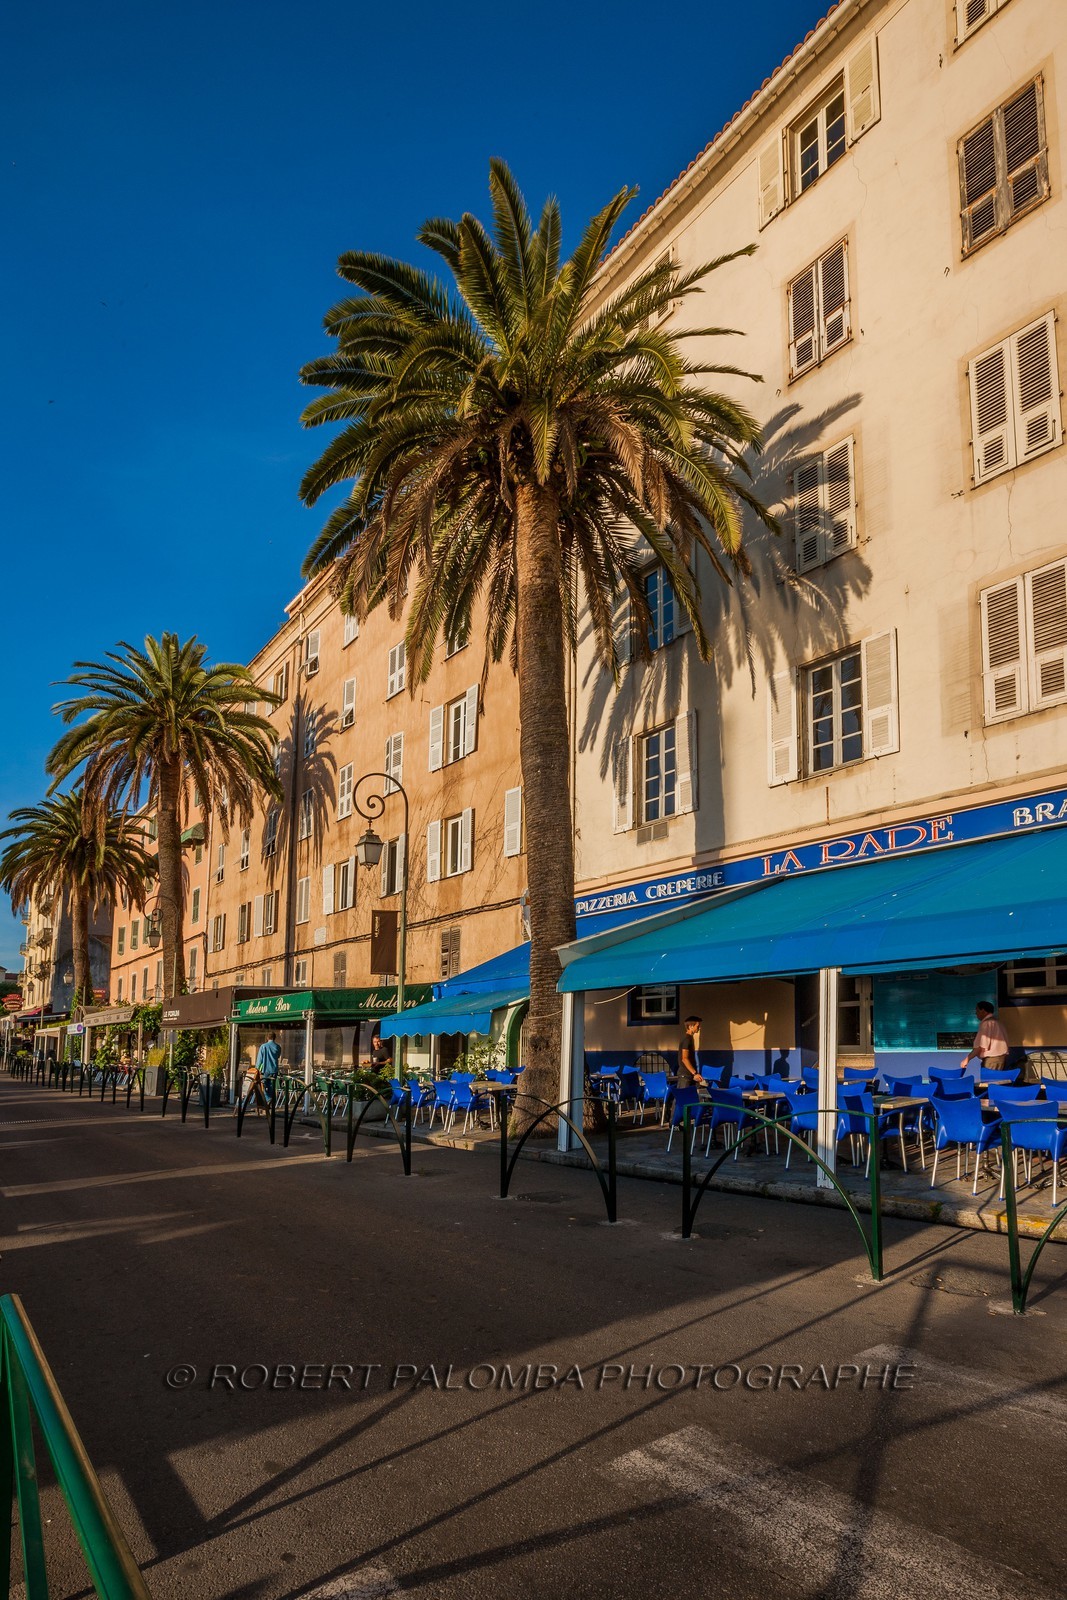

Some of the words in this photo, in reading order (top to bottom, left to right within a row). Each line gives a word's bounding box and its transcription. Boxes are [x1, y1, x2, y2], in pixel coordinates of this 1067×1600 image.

[761, 850, 806, 877] LA
[819, 815, 954, 865] RADE
[575, 890, 638, 914] PIZZERIA
[645, 871, 725, 899] CREPERIE
[275, 997, 291, 1012] Bar
